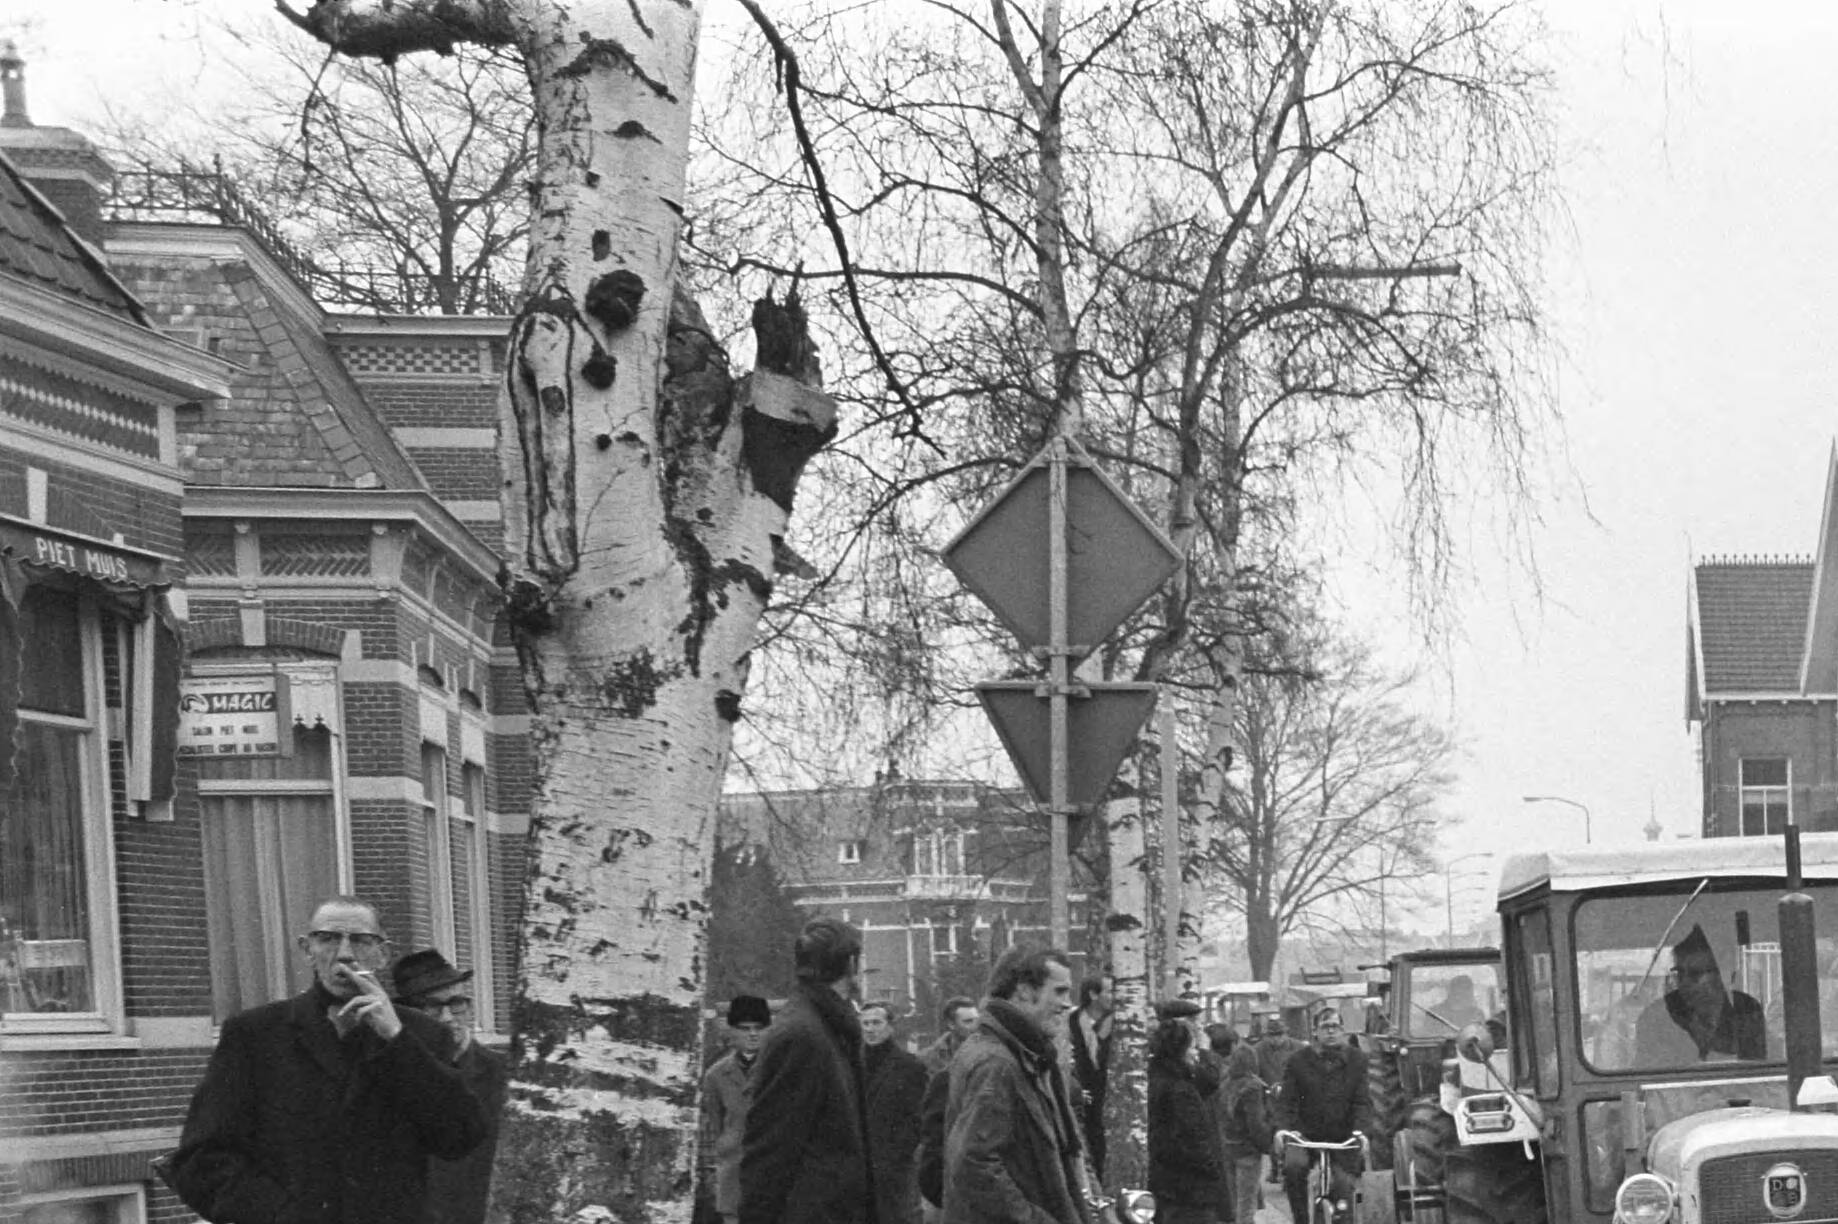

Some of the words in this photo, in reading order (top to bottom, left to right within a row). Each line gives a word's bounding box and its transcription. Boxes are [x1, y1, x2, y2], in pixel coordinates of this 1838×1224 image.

[34, 537, 76, 568] PIET
[85, 549, 128, 579] MUIS
[212, 693, 273, 711] MAGIC
